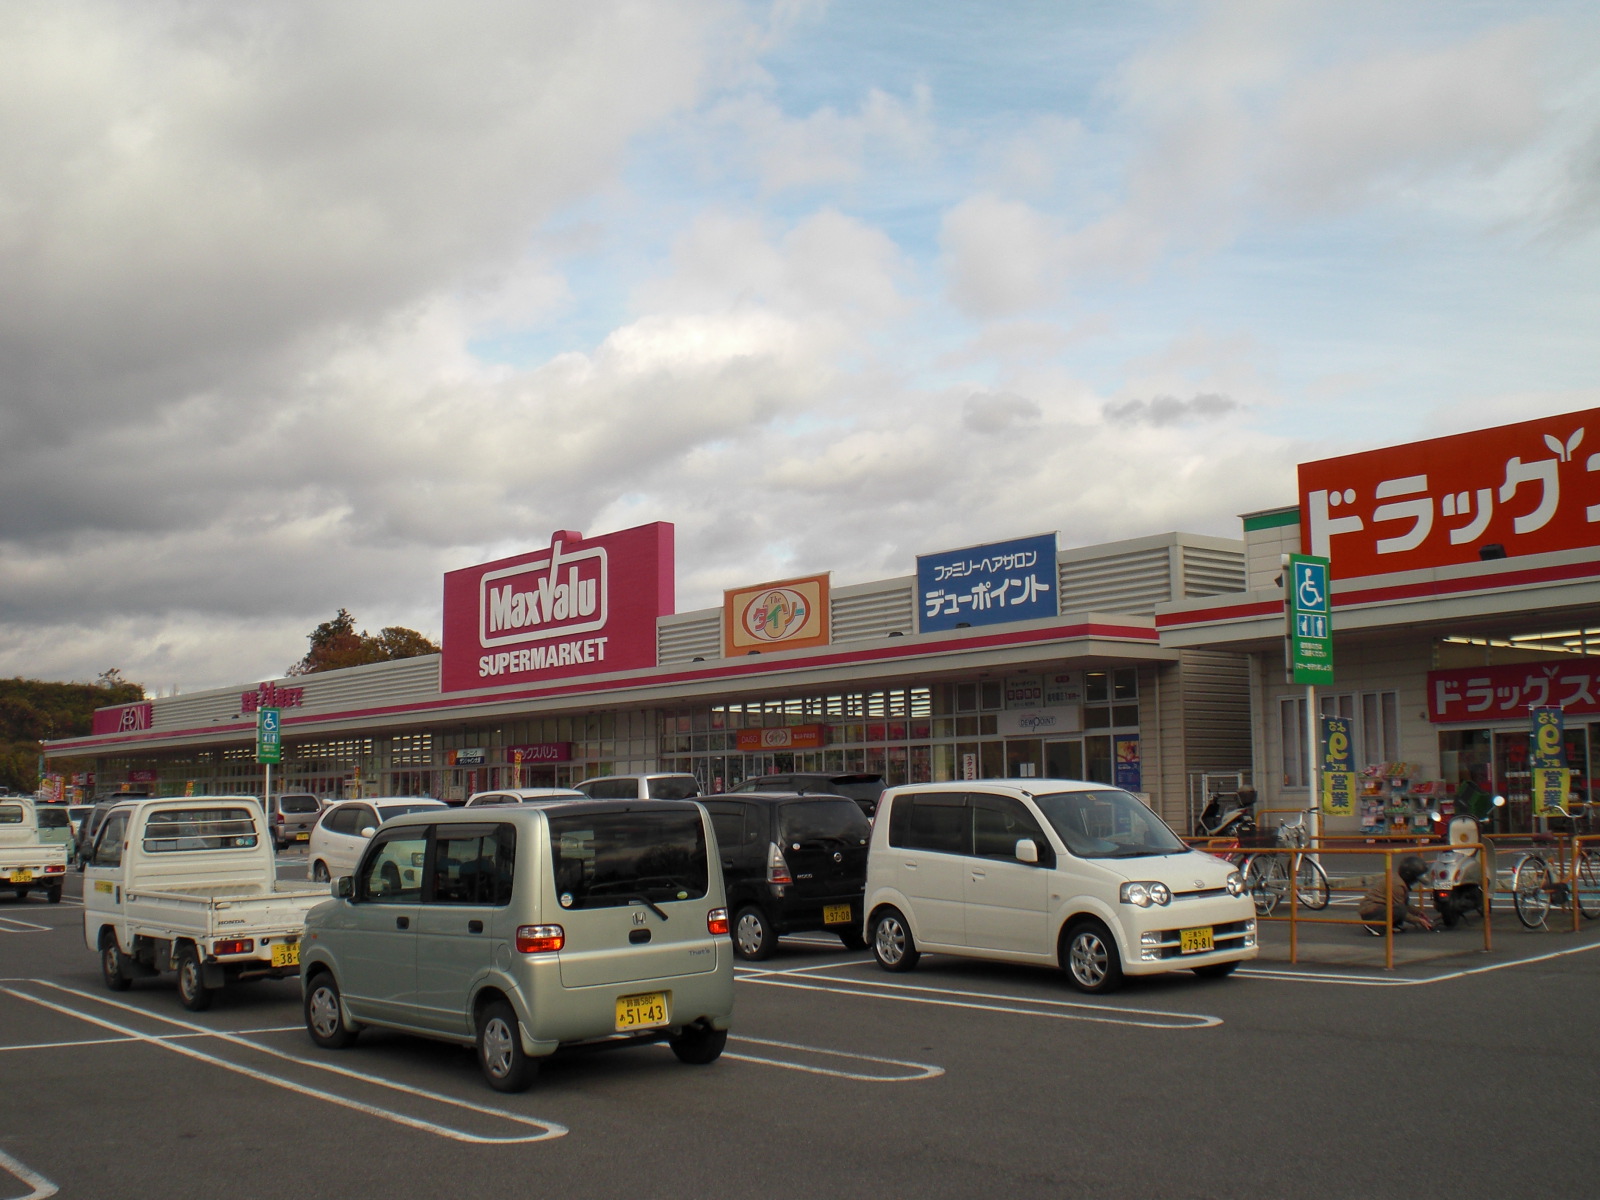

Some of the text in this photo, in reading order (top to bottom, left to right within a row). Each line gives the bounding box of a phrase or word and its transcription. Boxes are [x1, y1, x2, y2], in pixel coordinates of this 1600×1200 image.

[1308, 428, 1600, 563] ドラッグ
[934, 550, 1037, 581] ファミリーヘアサロン
[489, 540, 596, 633] MaxValu
[769, 597, 782, 605] The
[925, 573, 1050, 617] デューポイント
[753, 601, 805, 631] ダイソー
[478, 636, 608, 678] SUPERMARKET
[1435, 665, 1600, 715] ドラッグス
[741, 735, 758, 744] DAISO
[688, 948, 711, 956] That's
[1188, 937, 1211, 950] 79-81
[627, 1005, 663, 1024] 51-43
